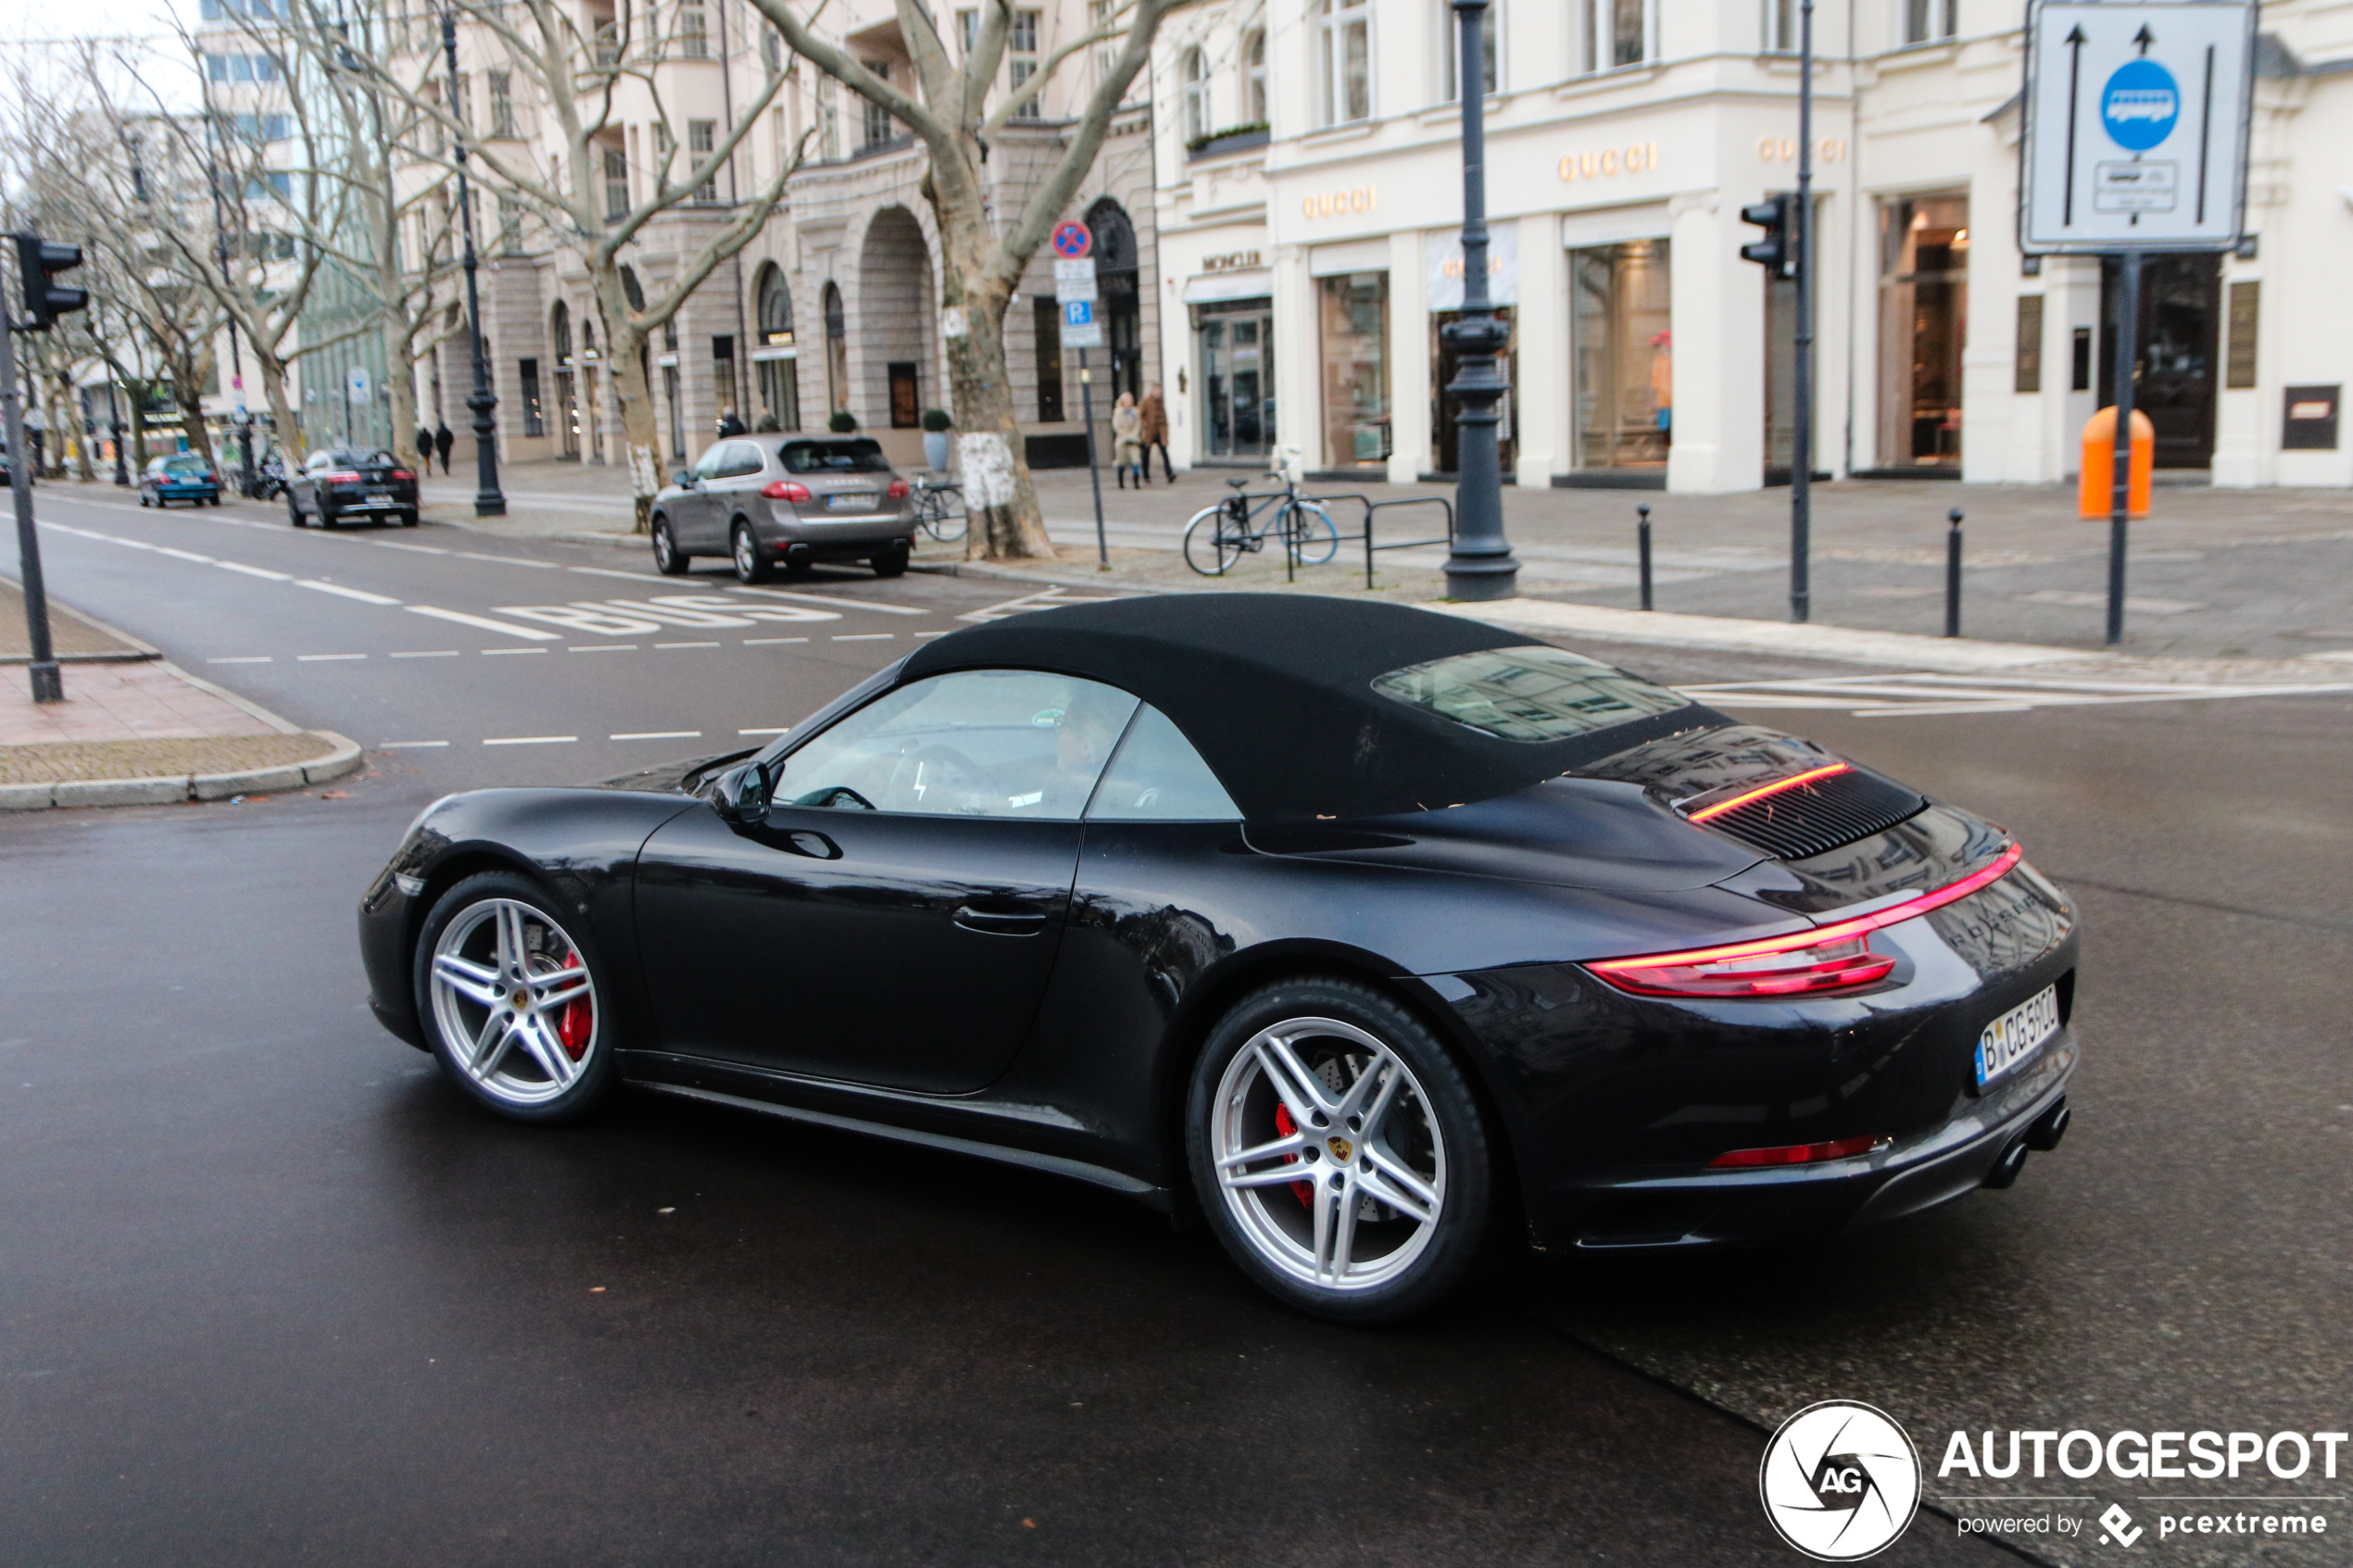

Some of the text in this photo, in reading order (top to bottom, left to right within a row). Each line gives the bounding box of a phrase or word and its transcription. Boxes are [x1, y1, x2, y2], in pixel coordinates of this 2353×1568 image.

[1558, 141, 1657, 183] GUCCI
[1756, 135, 1846, 164] GUCI
[1303, 184, 1378, 220] GUCCI
[490, 596, 842, 635] BUS
[1983, 1030, 1996, 1072] B
